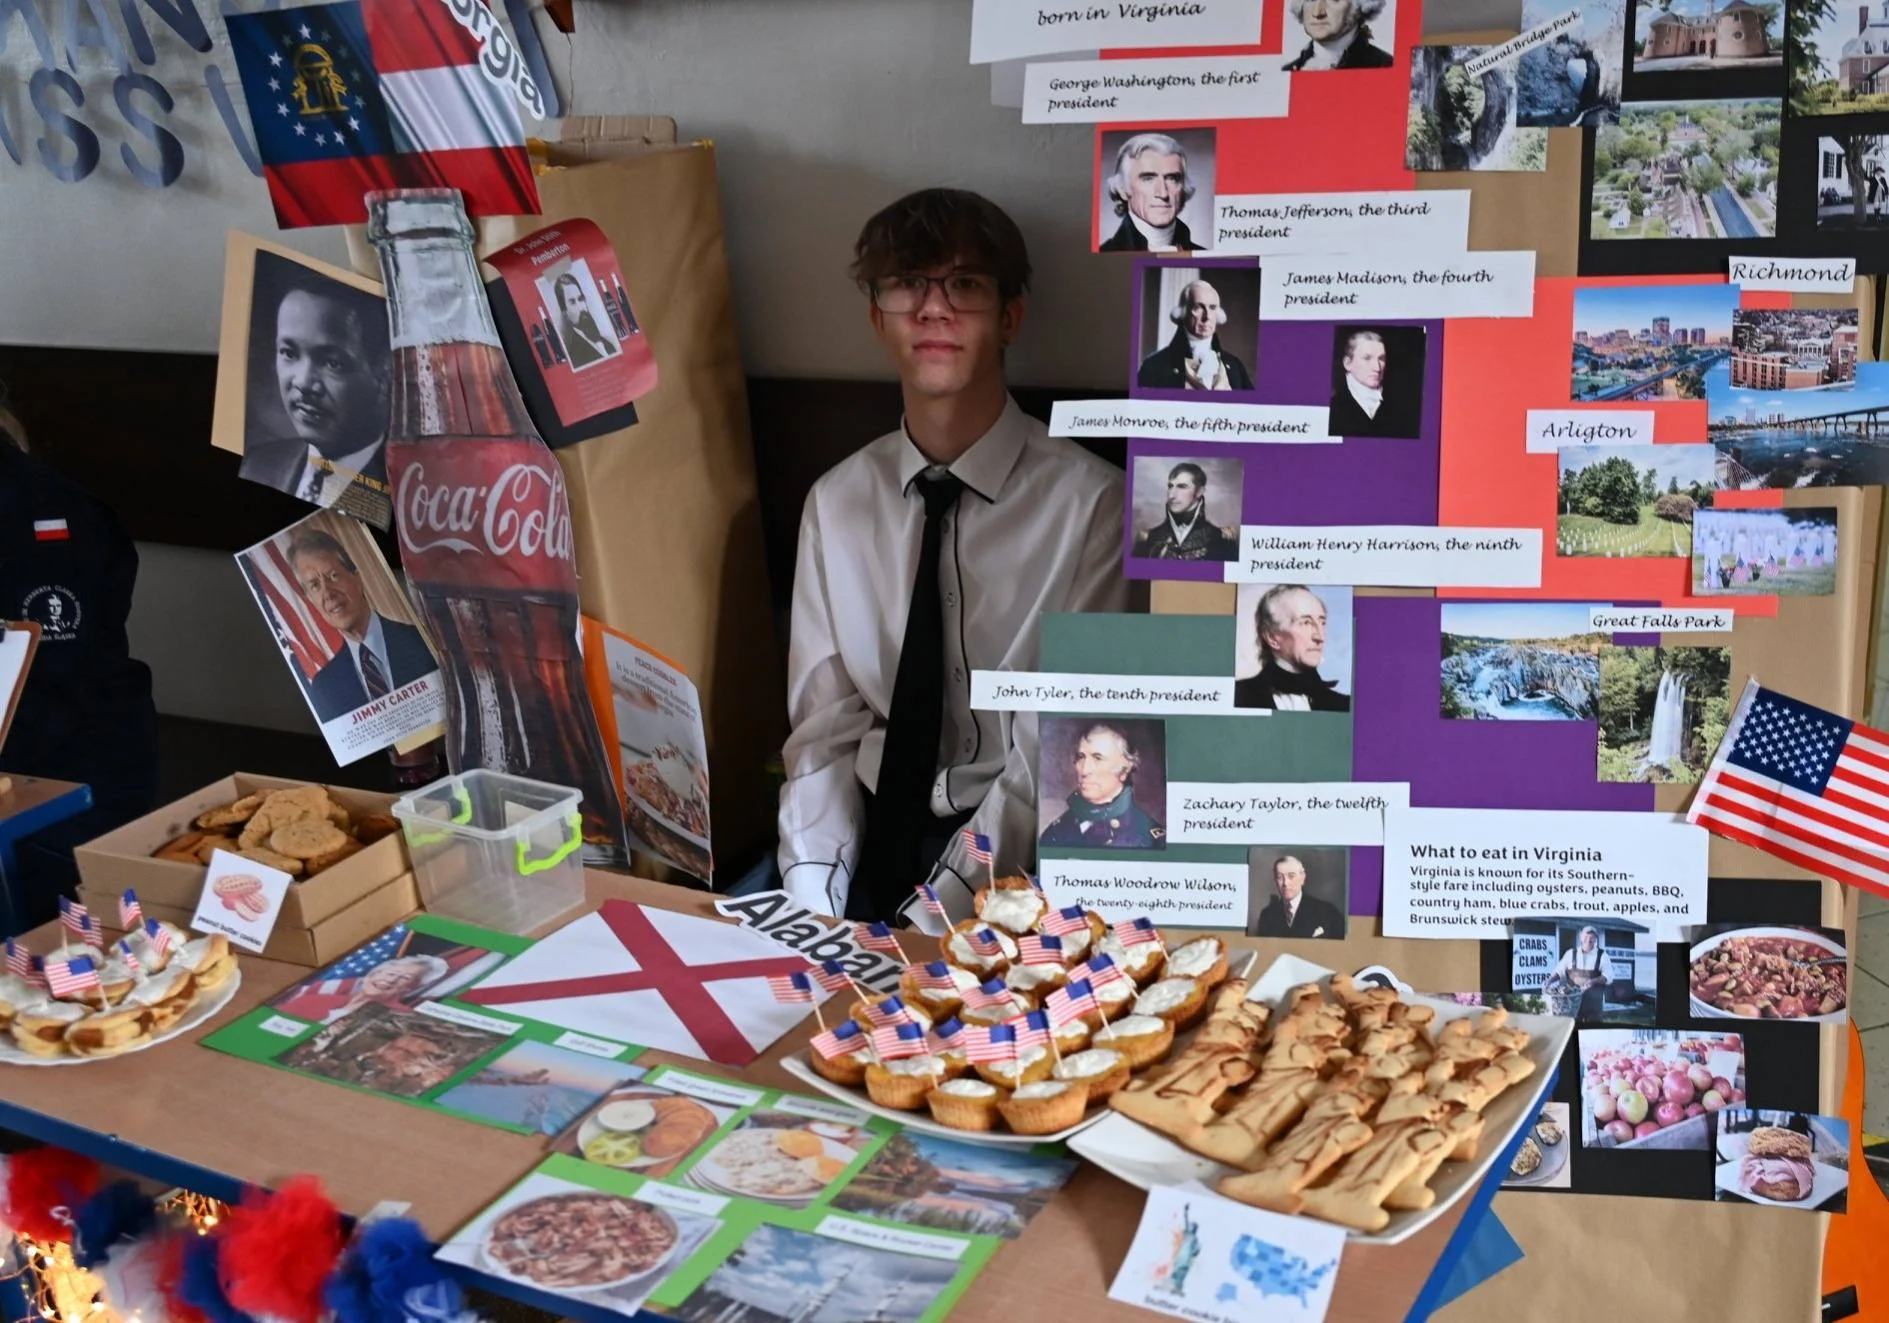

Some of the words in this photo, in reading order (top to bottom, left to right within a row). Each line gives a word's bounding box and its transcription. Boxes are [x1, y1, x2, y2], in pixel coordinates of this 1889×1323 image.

[1037, 10, 1081, 26] born
[1086, 7, 1110, 20] in
[1119, 2, 1206, 23] Virginia
[1467, 45, 1513, 74] Natural
[1513, 27, 1552, 51] Bridge
[1552, 9, 1581, 31] Park
[1049, 77, 1099, 93] George
[1103, 73, 1195, 90] Washington,
[1201, 71, 1225, 84] the
[1228, 70, 1260, 87] first
[1047, 96, 1118, 112] president
[1220, 205, 1280, 218] Thomas
[1280, 204, 1353, 220] Jefferson,
[1358, 203, 1384, 216] the
[1387, 202, 1431, 216] third
[1218, 226, 1291, 242] president
[531, 243, 571, 266] Pemberton
[1283, 271, 1333, 286] James
[1336, 271, 1407, 285] Madison,
[1412, 270, 1439, 284] the
[1440, 268, 1494, 286] fourth
[1731, 260, 1854, 284] Richmond
[1284, 292, 1358, 308] president
[1068, 416, 1109, 430] James
[1112, 415, 1169, 430] Monroe,
[1174, 416, 1201, 430] the
[1201, 416, 1236, 433] fifth
[1236, 420, 1310, 436] president
[1541, 419, 1638, 446] Arligton
[1251, 536, 1315, 550] William
[1316, 537, 1364, 553] Henry
[1366, 537, 1440, 552] Harrison,
[1445, 537, 1472, 551] the
[1475, 537, 1522, 551] ninth
[1250, 557, 1324, 573] president
[1592, 614, 1639, 628] Great
[1641, 614, 1681, 629] Falls
[1685, 614, 1726, 628] Park
[351, 699, 387, 725] JIMMY
[389, 680, 429, 706] CARTER
[992, 685, 1031, 700] John
[1034, 685, 1074, 702] Tyler,
[1079, 686, 1103, 700] the
[1106, 687, 1147, 701] tenth
[1149, 688, 1221, 704] president
[1183, 797, 1246, 813] Zachary
[1249, 797, 1301, 813] Taylor,
[1307, 797, 1333, 810] the
[1335, 796, 1389, 811] twelfth
[1183, 817, 1255, 832] president
[1410, 844, 1456, 859] What
[1460, 846, 1477, 859] to
[1481, 847, 1508, 860] eat
[1512, 846, 1529, 860] in
[1533, 846, 1602, 865] Virginia
[1410, 865, 1461, 879] Virginia
[1464, 866, 1475, 877] is
[1478, 867, 1523, 878] known
[1526, 868, 1545, 879] for
[1548, 868, 1564, 879] its
[1567, 869, 1635, 881] Southern-
[1053, 875, 1110, 888] Thomas
[1113, 876, 1181, 890] Woodrow
[1184, 878, 1237, 892] Wilson,
[1410, 880, 1441, 893] style
[1444, 880, 1469, 891] fare
[1472, 881, 1533, 896] including
[1652, 885, 1684, 899] BBQ,
[1076, 897, 1094, 907] the
[1096, 898, 1176, 911] twenty-eighth
[1178, 900, 1234, 912] president
[1410, 898, 1460, 911] country
[1499, 898, 1527, 909] blue
[1530, 899, 1569, 911] crabs,
[1573, 900, 1609, 912] trout,
[1613, 902, 1660, 915] apples,
[1663, 903, 1689, 914] and
[198, 915, 219, 928] peanut
[1410, 913, 1477, 925] Brunswick
[1519, 938, 1548, 951] CRABS
[1518, 955, 1548, 967] CLAMS
[1144, 1294, 1180, 1311] butter
